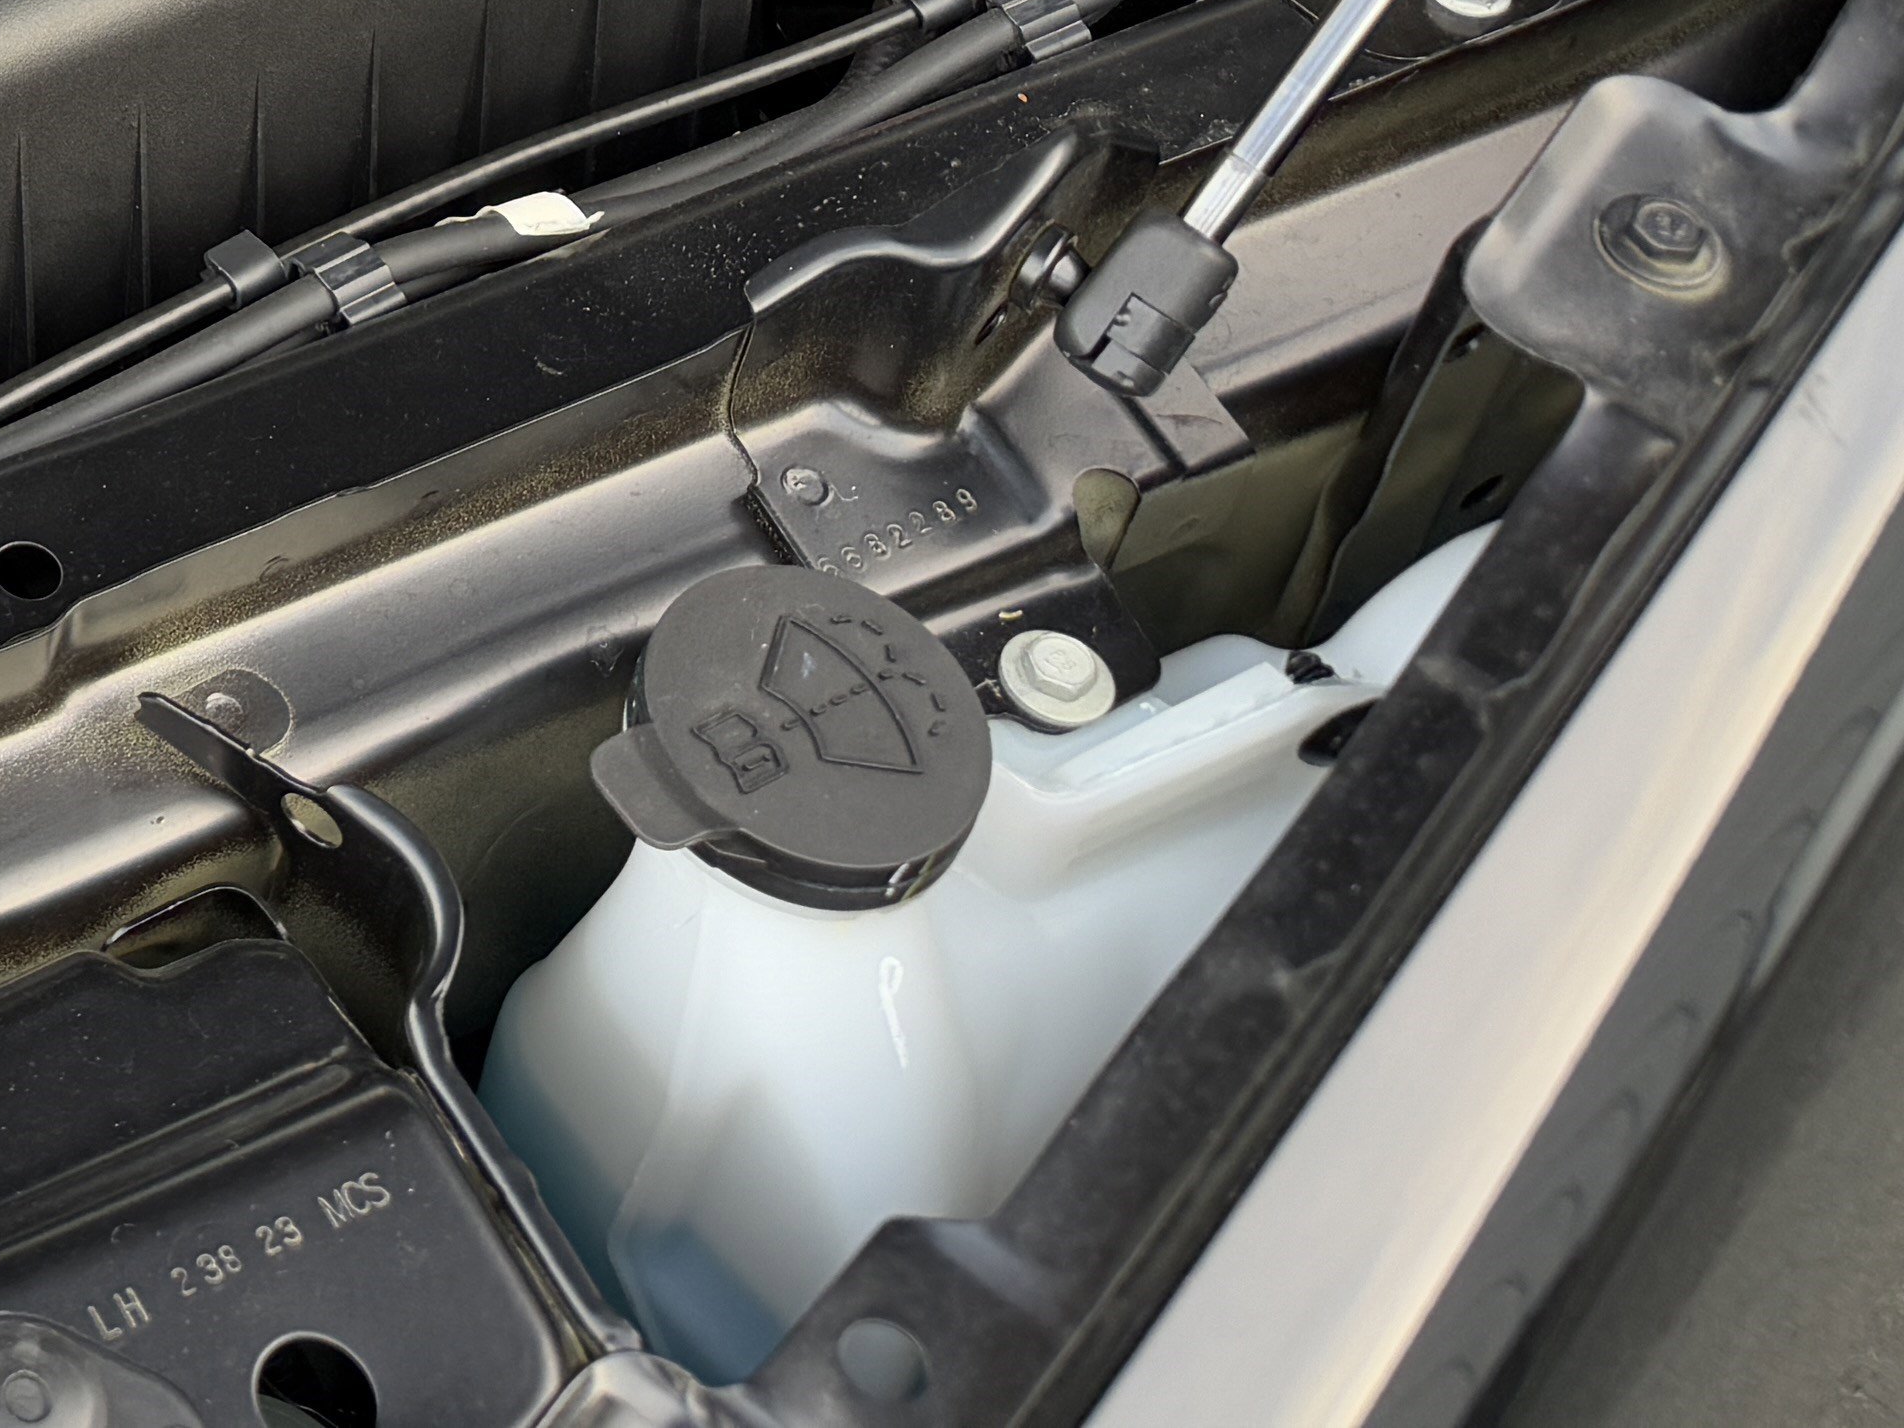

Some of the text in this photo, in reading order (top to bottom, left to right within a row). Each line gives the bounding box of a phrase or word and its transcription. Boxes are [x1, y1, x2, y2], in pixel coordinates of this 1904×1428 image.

[87, 1286, 152, 1342] LH
[254, 1215, 305, 1257] 23
[317, 1171, 393, 1230] MCS
